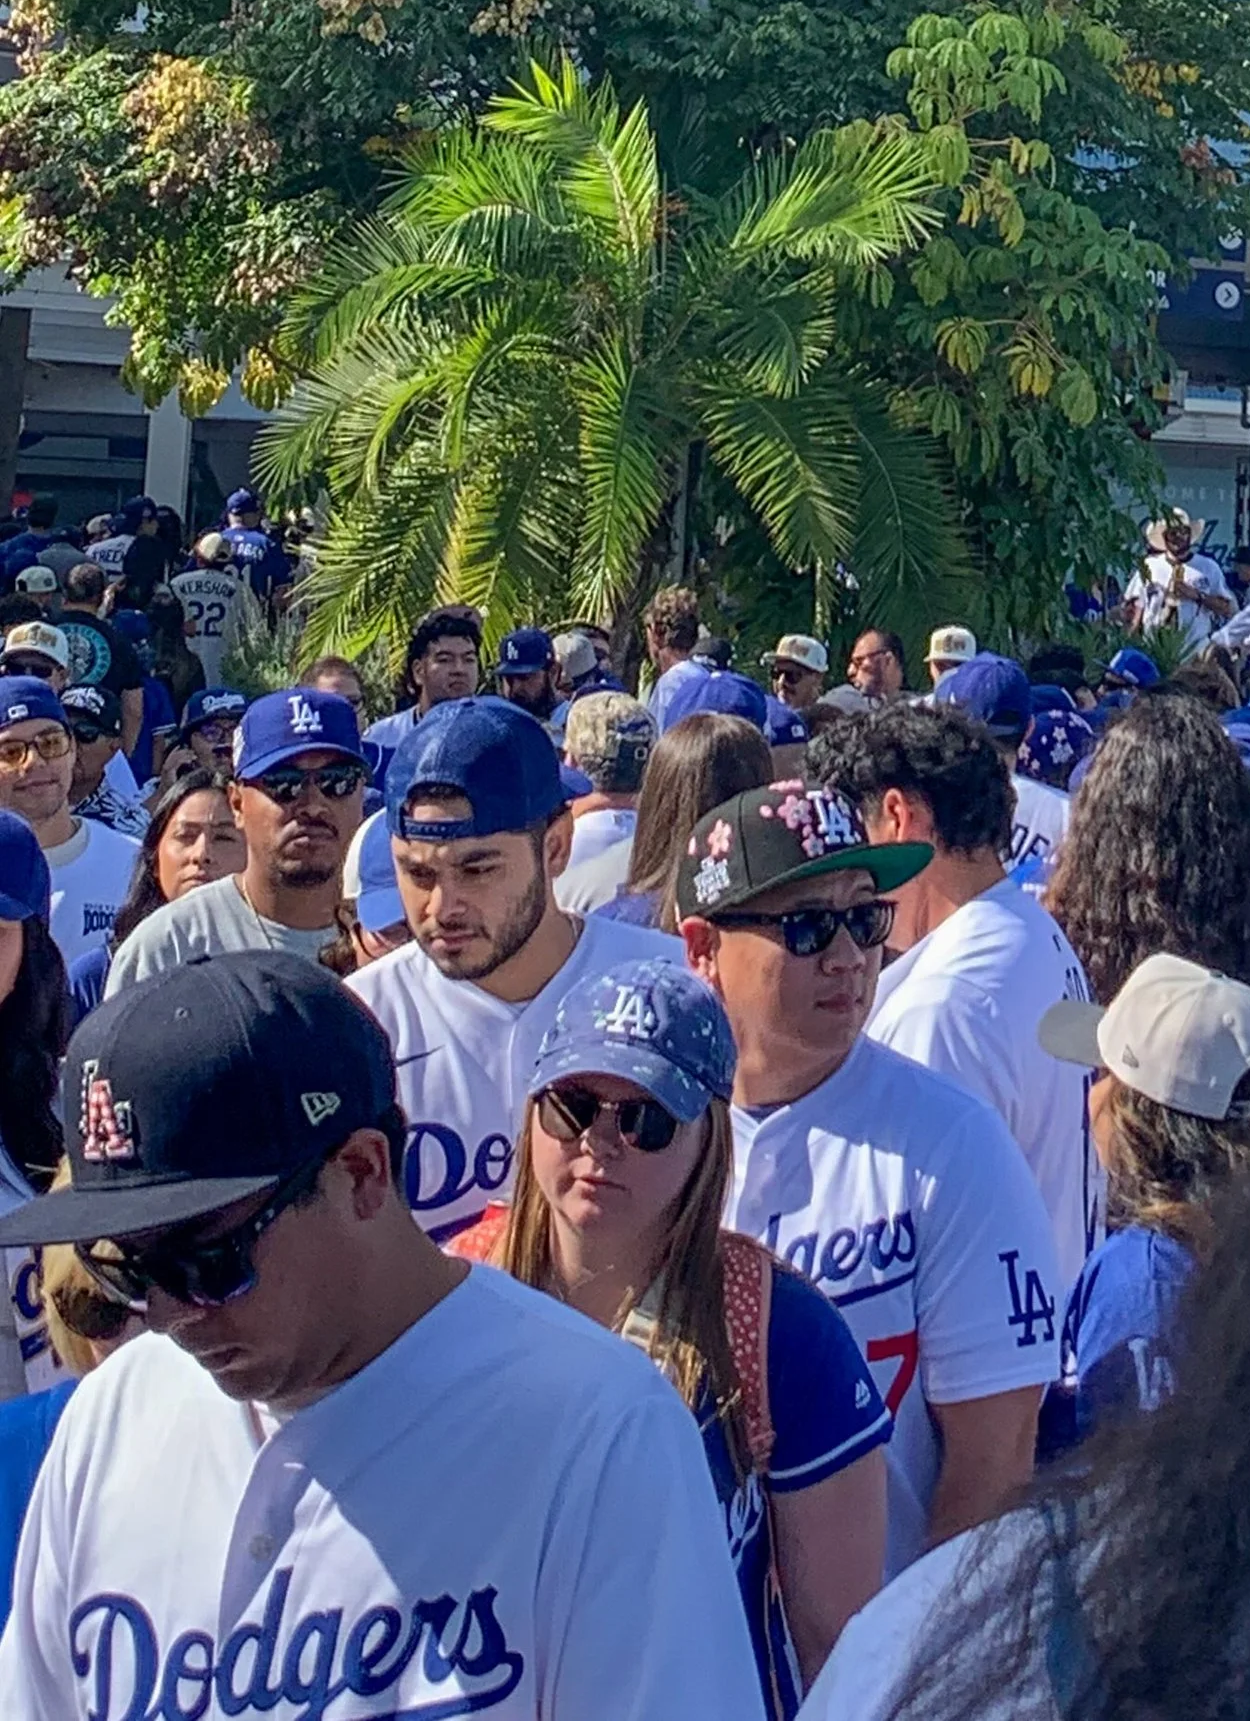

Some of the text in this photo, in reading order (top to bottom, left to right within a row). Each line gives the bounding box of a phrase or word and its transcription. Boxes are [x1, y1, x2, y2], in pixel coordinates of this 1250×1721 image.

[180, 579, 237, 599] KERSHAW
[187, 601, 227, 638] 22
[288, 694, 324, 734] LA
[806, 790, 862, 845] LA
[605, 985, 655, 1039] LA
[79, 1059, 135, 1161] LA
[998, 1250, 1056, 1348] LA
[68, 1563, 524, 1721] Dodgers
